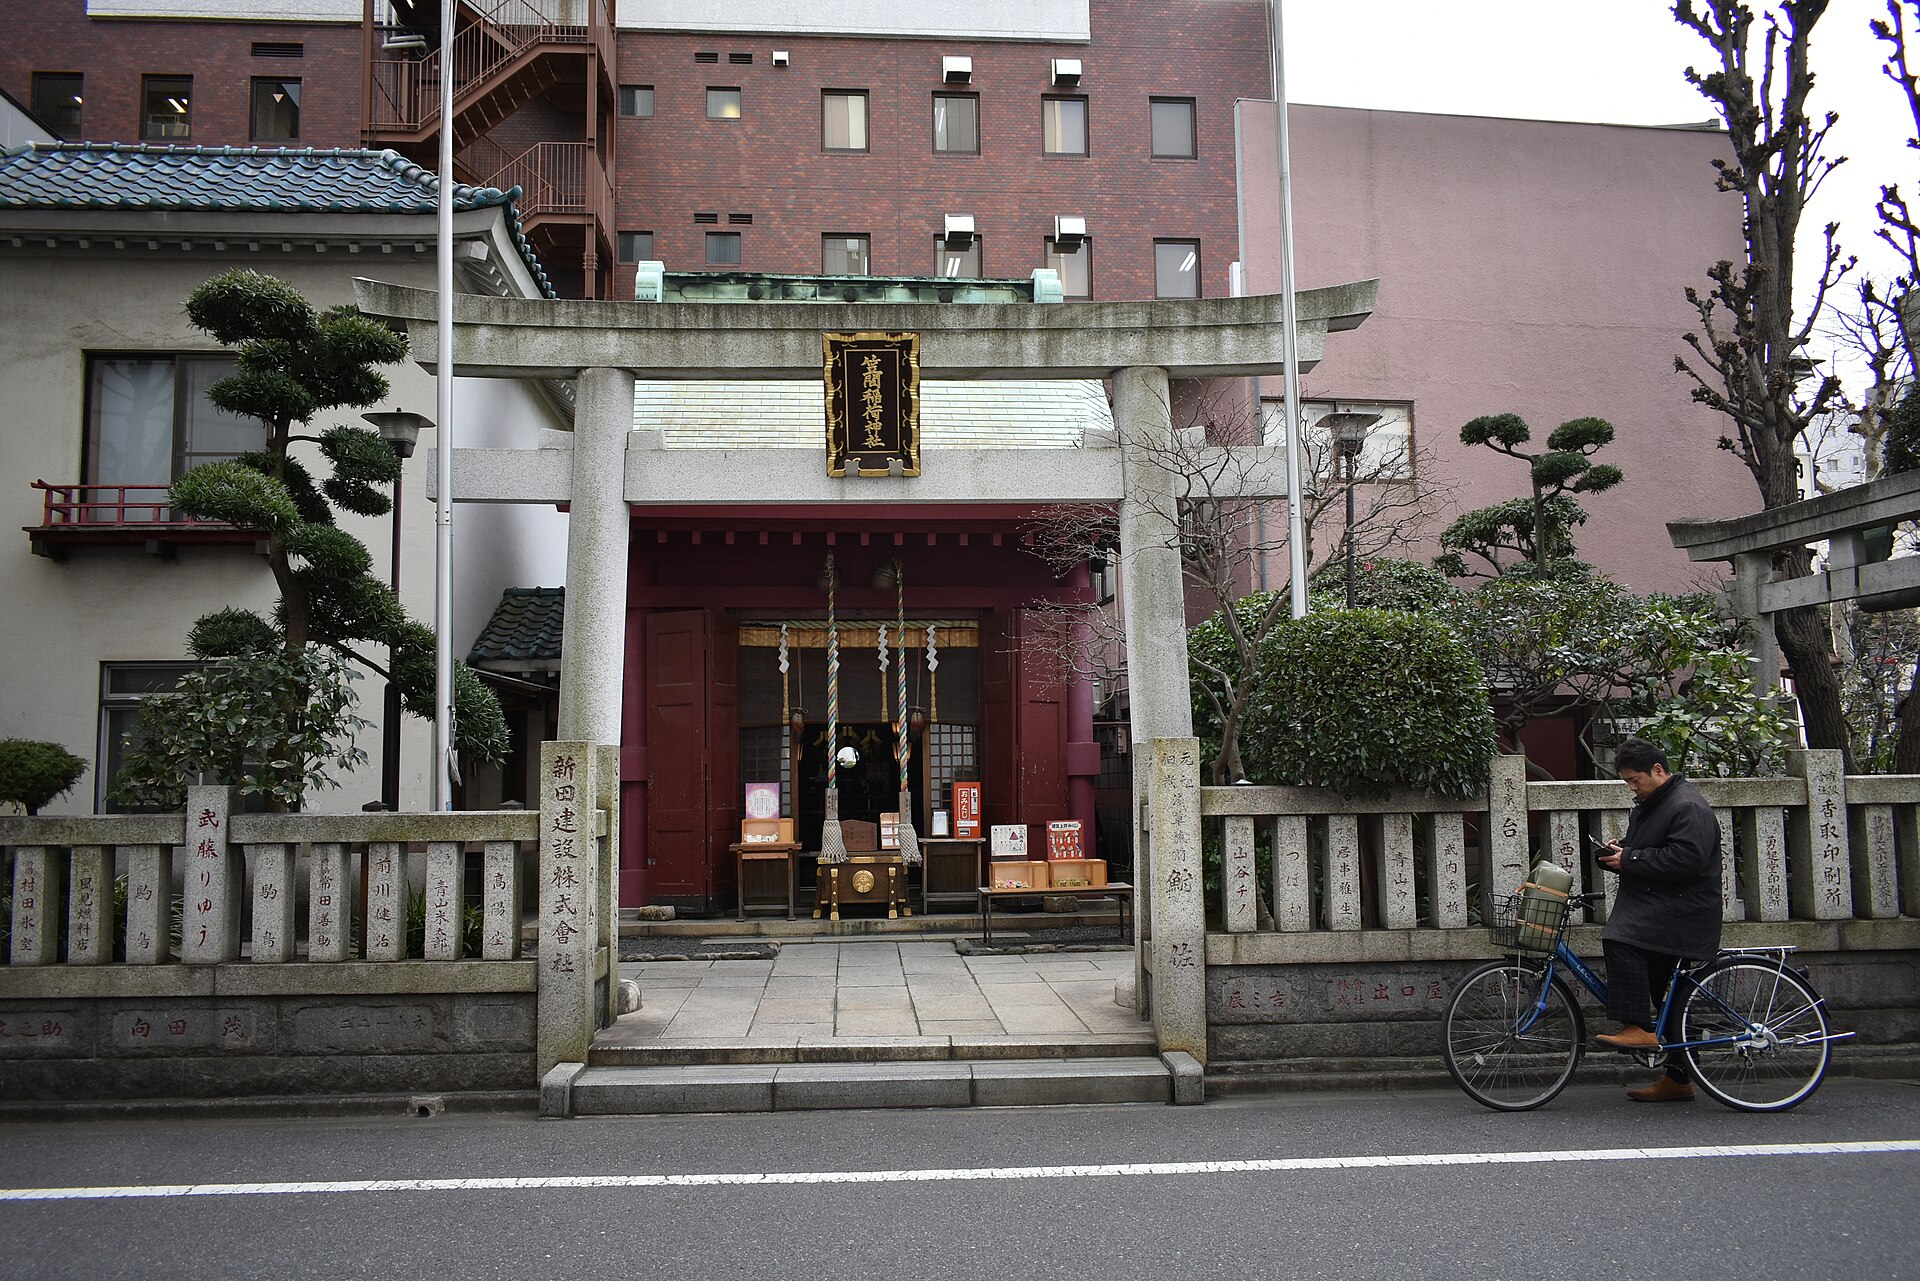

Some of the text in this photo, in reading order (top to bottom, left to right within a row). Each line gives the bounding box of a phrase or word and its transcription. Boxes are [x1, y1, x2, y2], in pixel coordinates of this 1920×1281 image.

[860, 354, 885, 448] 笠間稲荷神社
[551, 755, 579, 974] 新田建設株式會社
[1819, 799, 1842, 907] 香取印刷所
[375, 857, 391, 948] 前川健治
[130, 1015, 245, 1039] 向田茂
[1373, 981, 1443, 1001] 出口屋
